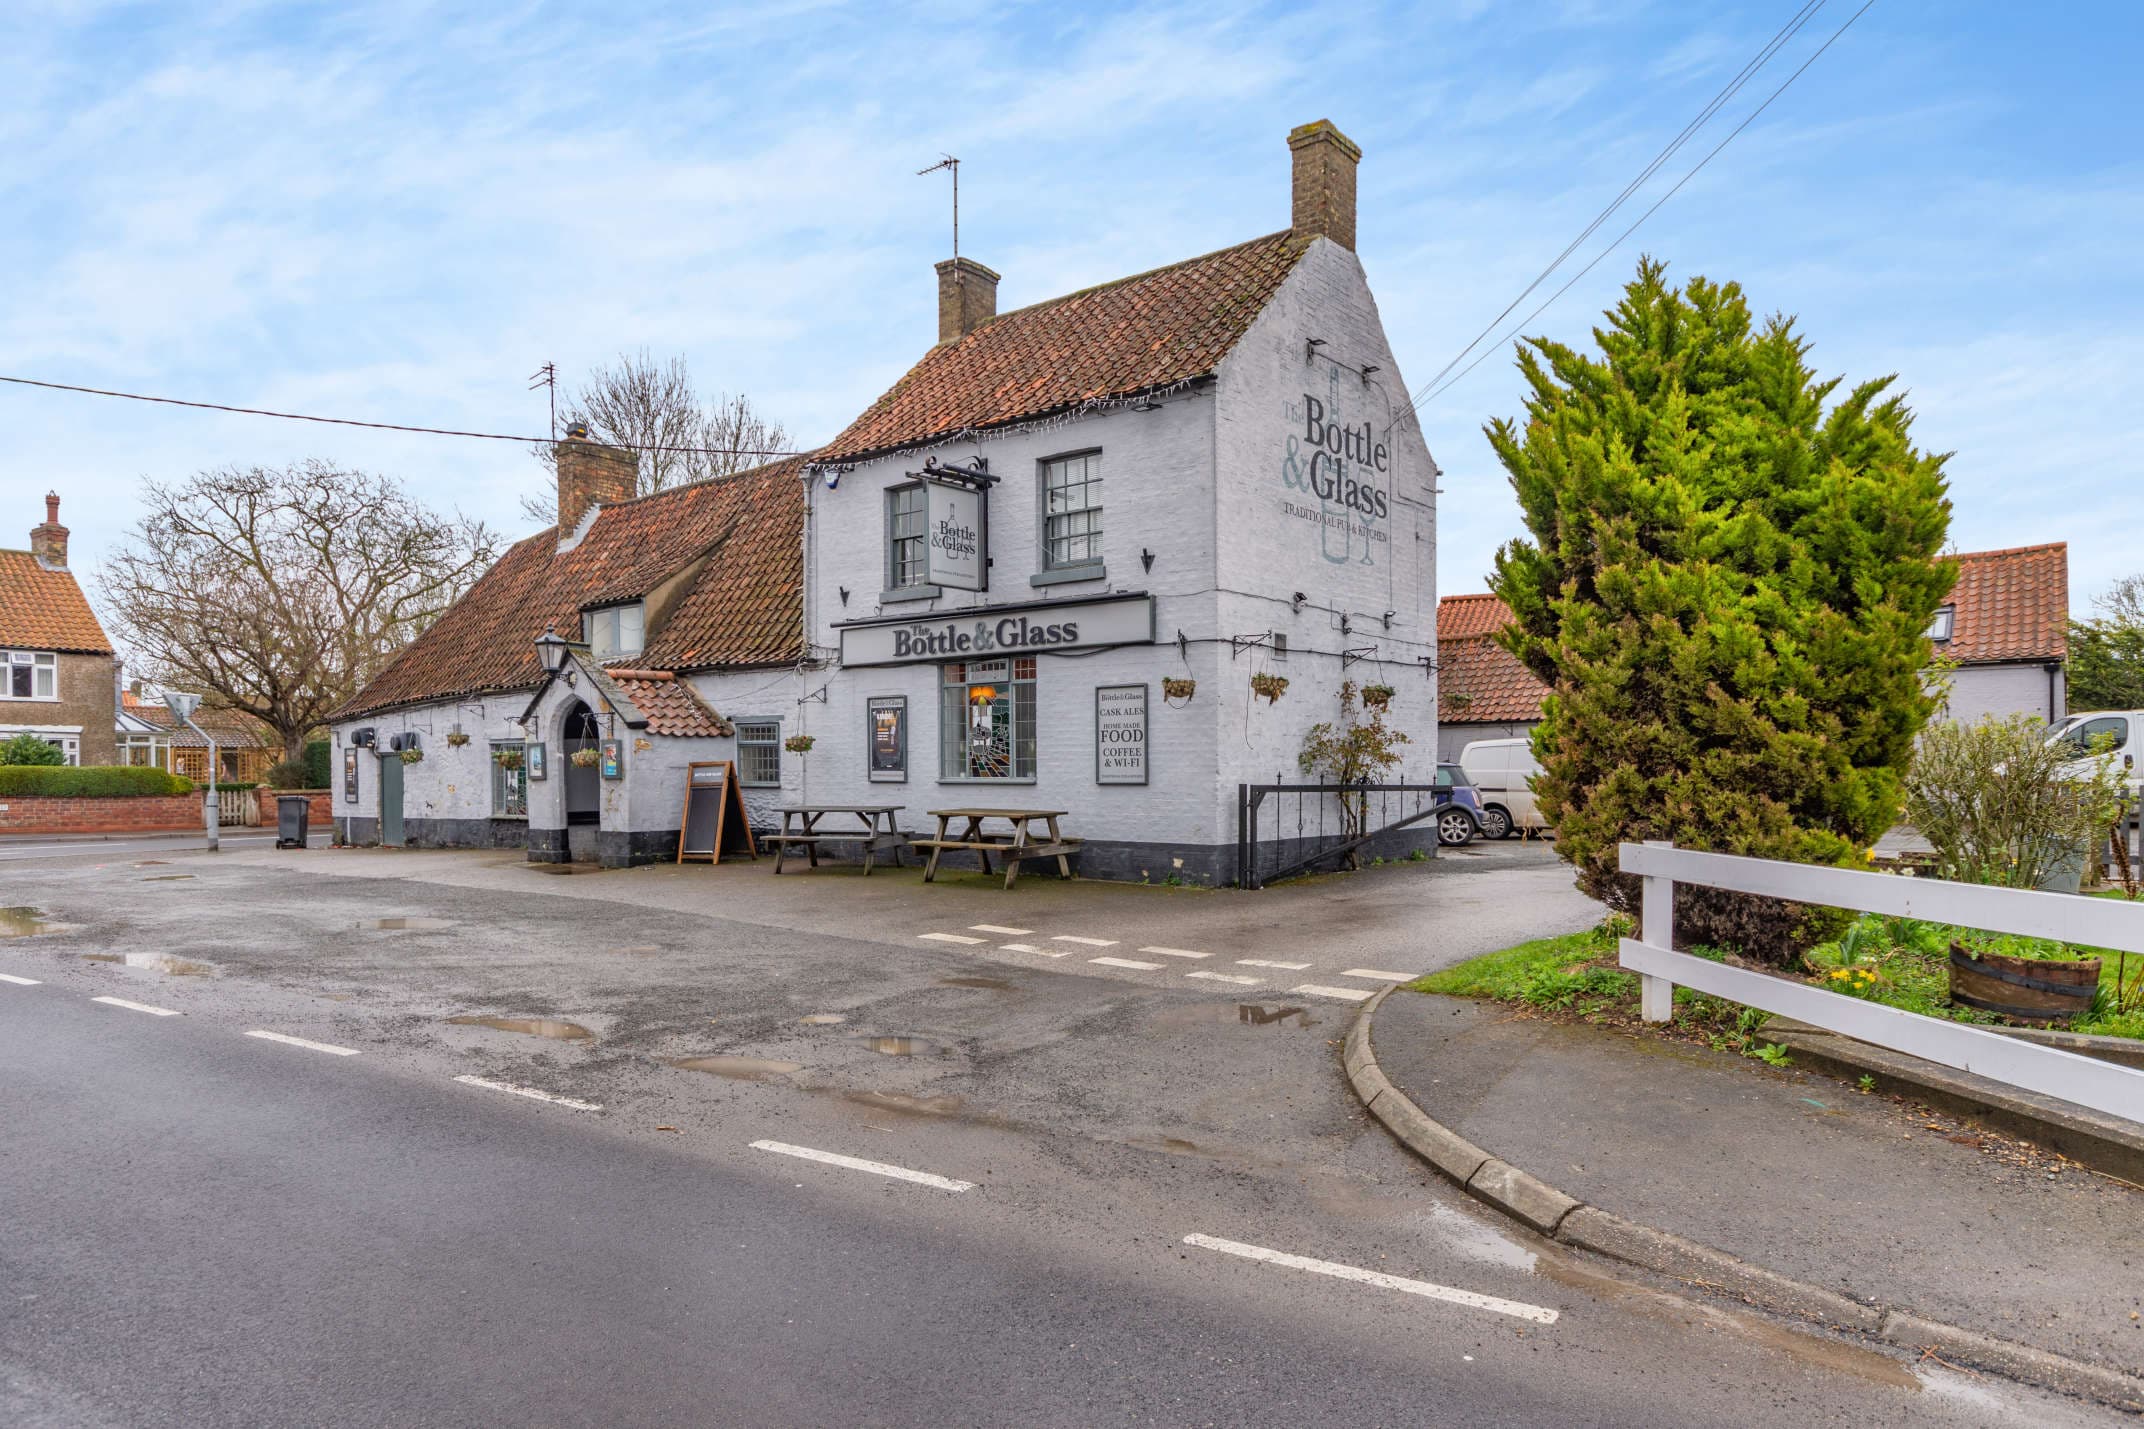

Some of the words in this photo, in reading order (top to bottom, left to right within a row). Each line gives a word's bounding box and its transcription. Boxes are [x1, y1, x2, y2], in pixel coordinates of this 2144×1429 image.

[1283, 400, 1304, 425] The
[1303, 393, 1387, 472] Bottle
[1284, 502, 1337, 528] TRADITIONAL
[1337, 519, 1350, 532] PUB
[1351, 526, 1357, 535] &
[1358, 524, 1387, 543] KITCHEN
[940, 521, 976, 541] Bottle
[910, 624, 930, 637] The
[1100, 708, 1121, 717] CASK
[1123, 707, 1144, 716] ALES
[1101, 729, 1143, 743] FOOD
[1103, 747, 1142, 757] COFFEE
[1114, 758, 1140, 767] WI-FI
